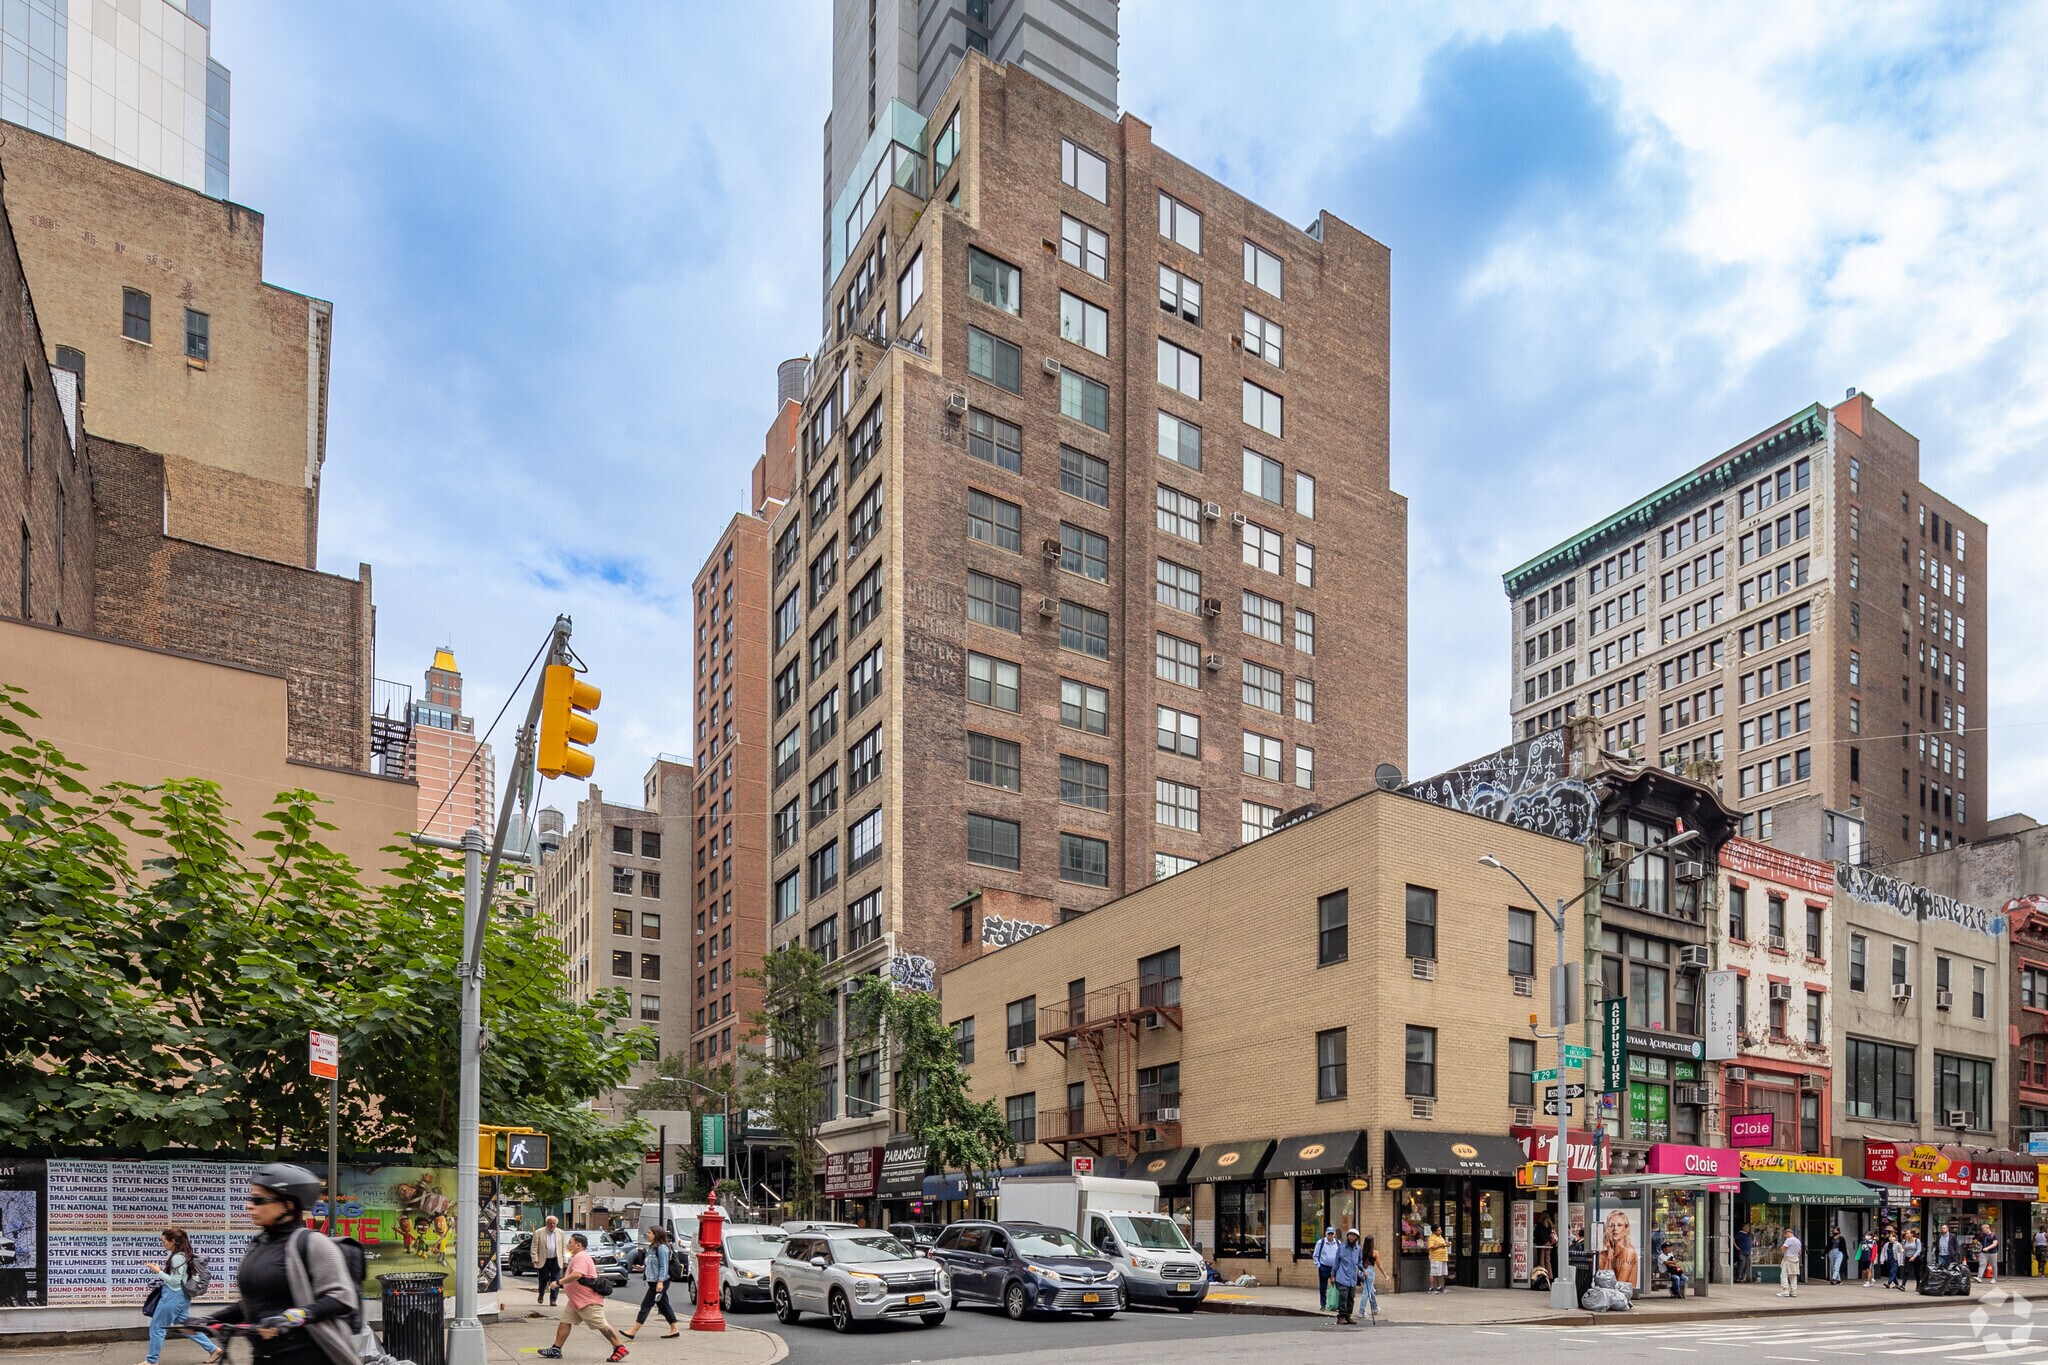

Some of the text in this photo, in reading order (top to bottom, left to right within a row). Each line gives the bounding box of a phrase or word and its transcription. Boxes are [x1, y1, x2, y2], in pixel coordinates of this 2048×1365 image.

[312, 1033, 319, 1045] NO
[1627, 1036, 1692, 1052] UYAMA ACUPUNCTURE
[1534, 1072, 1539, 1080] W
[1542, 1071, 1550, 1079] 29
[1676, 1067, 1693, 1076] OPEN
[1734, 1122, 1769, 1135] Cloie
[1538, 1134, 1558, 1176] $1
[1912, 1150, 1936, 1160] Yurim
[1685, 1154, 1717, 1172] Cloie
[1788, 1158, 1836, 1173] FLORISTS
[1909, 1160, 1936, 1170] HAT
[1284, 1169, 1321, 1177] WHOLESALER
[1976, 1168, 2034, 1184] J & Jin TRADING
[1788, 1194, 1864, 1205] New York's Leading Florist
[306, 1218, 380, 1244] ATE
[1514, 1254, 1526, 1262] PIZZA
